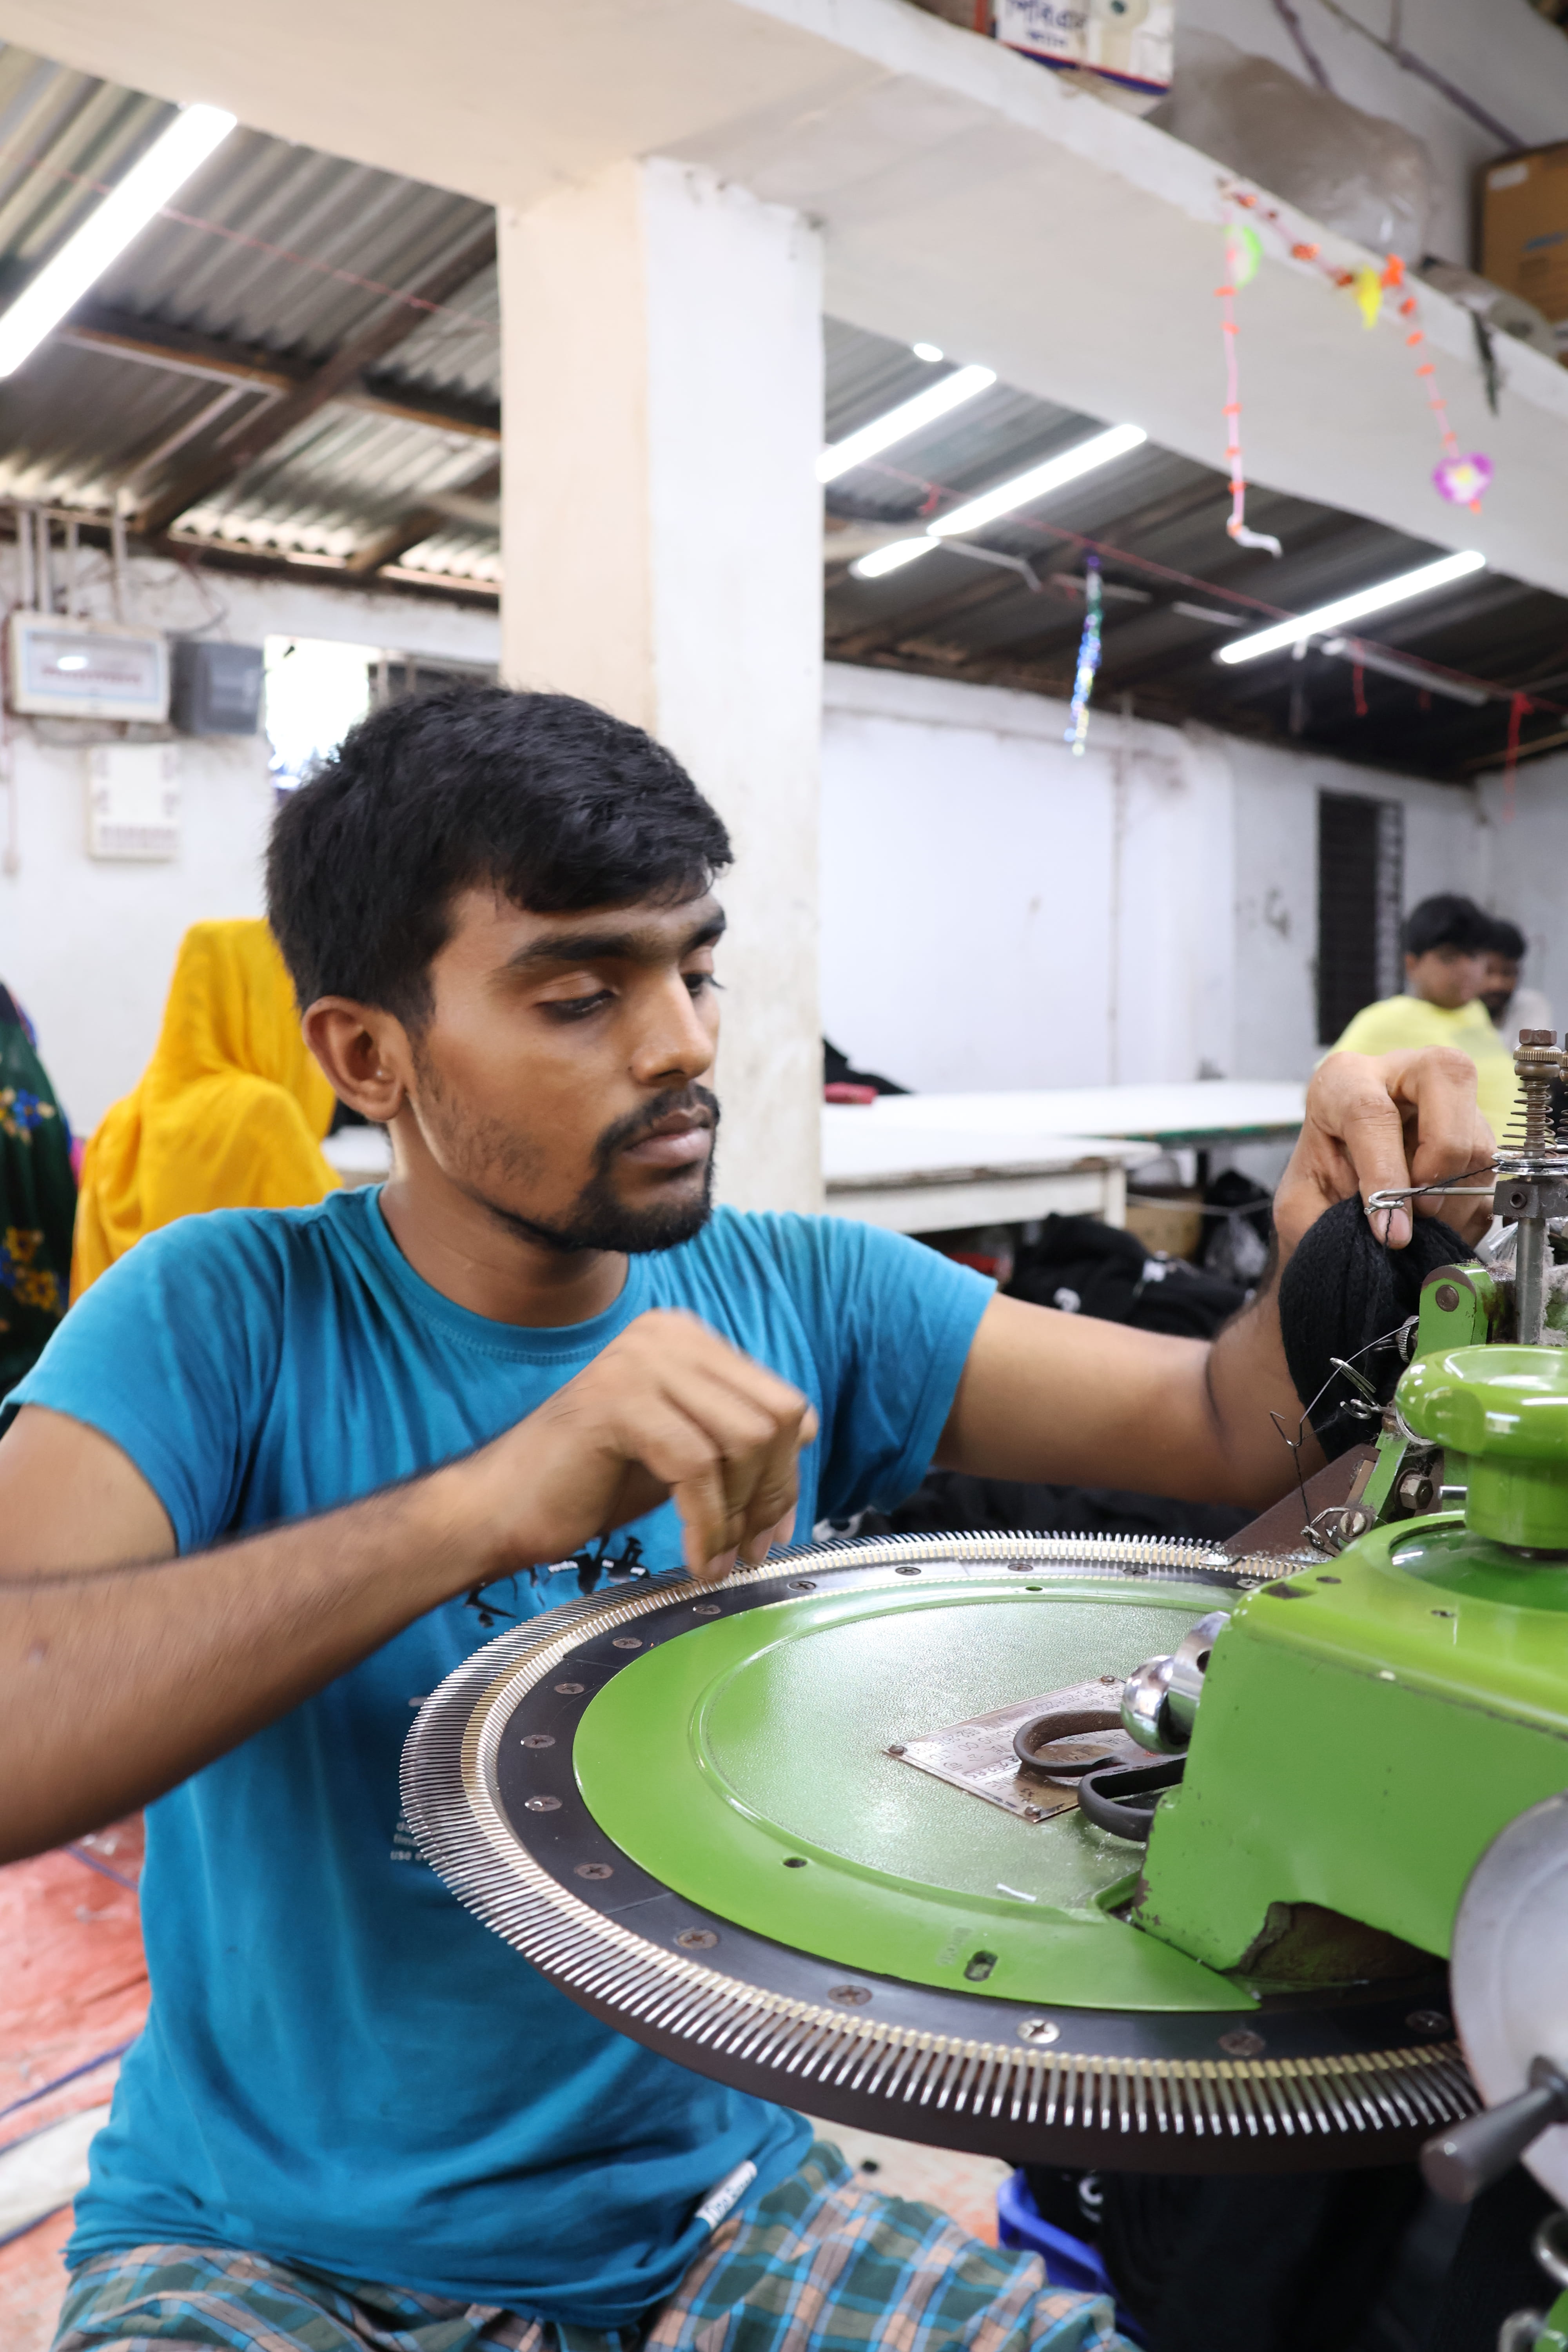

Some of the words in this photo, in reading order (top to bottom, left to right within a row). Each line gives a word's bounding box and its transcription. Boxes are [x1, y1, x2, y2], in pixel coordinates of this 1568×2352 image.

[1100, 1690, 1126, 1702] UNG
[978, 1726, 1024, 1744] RADING
[1096, 1734, 1131, 1747] DIAL
